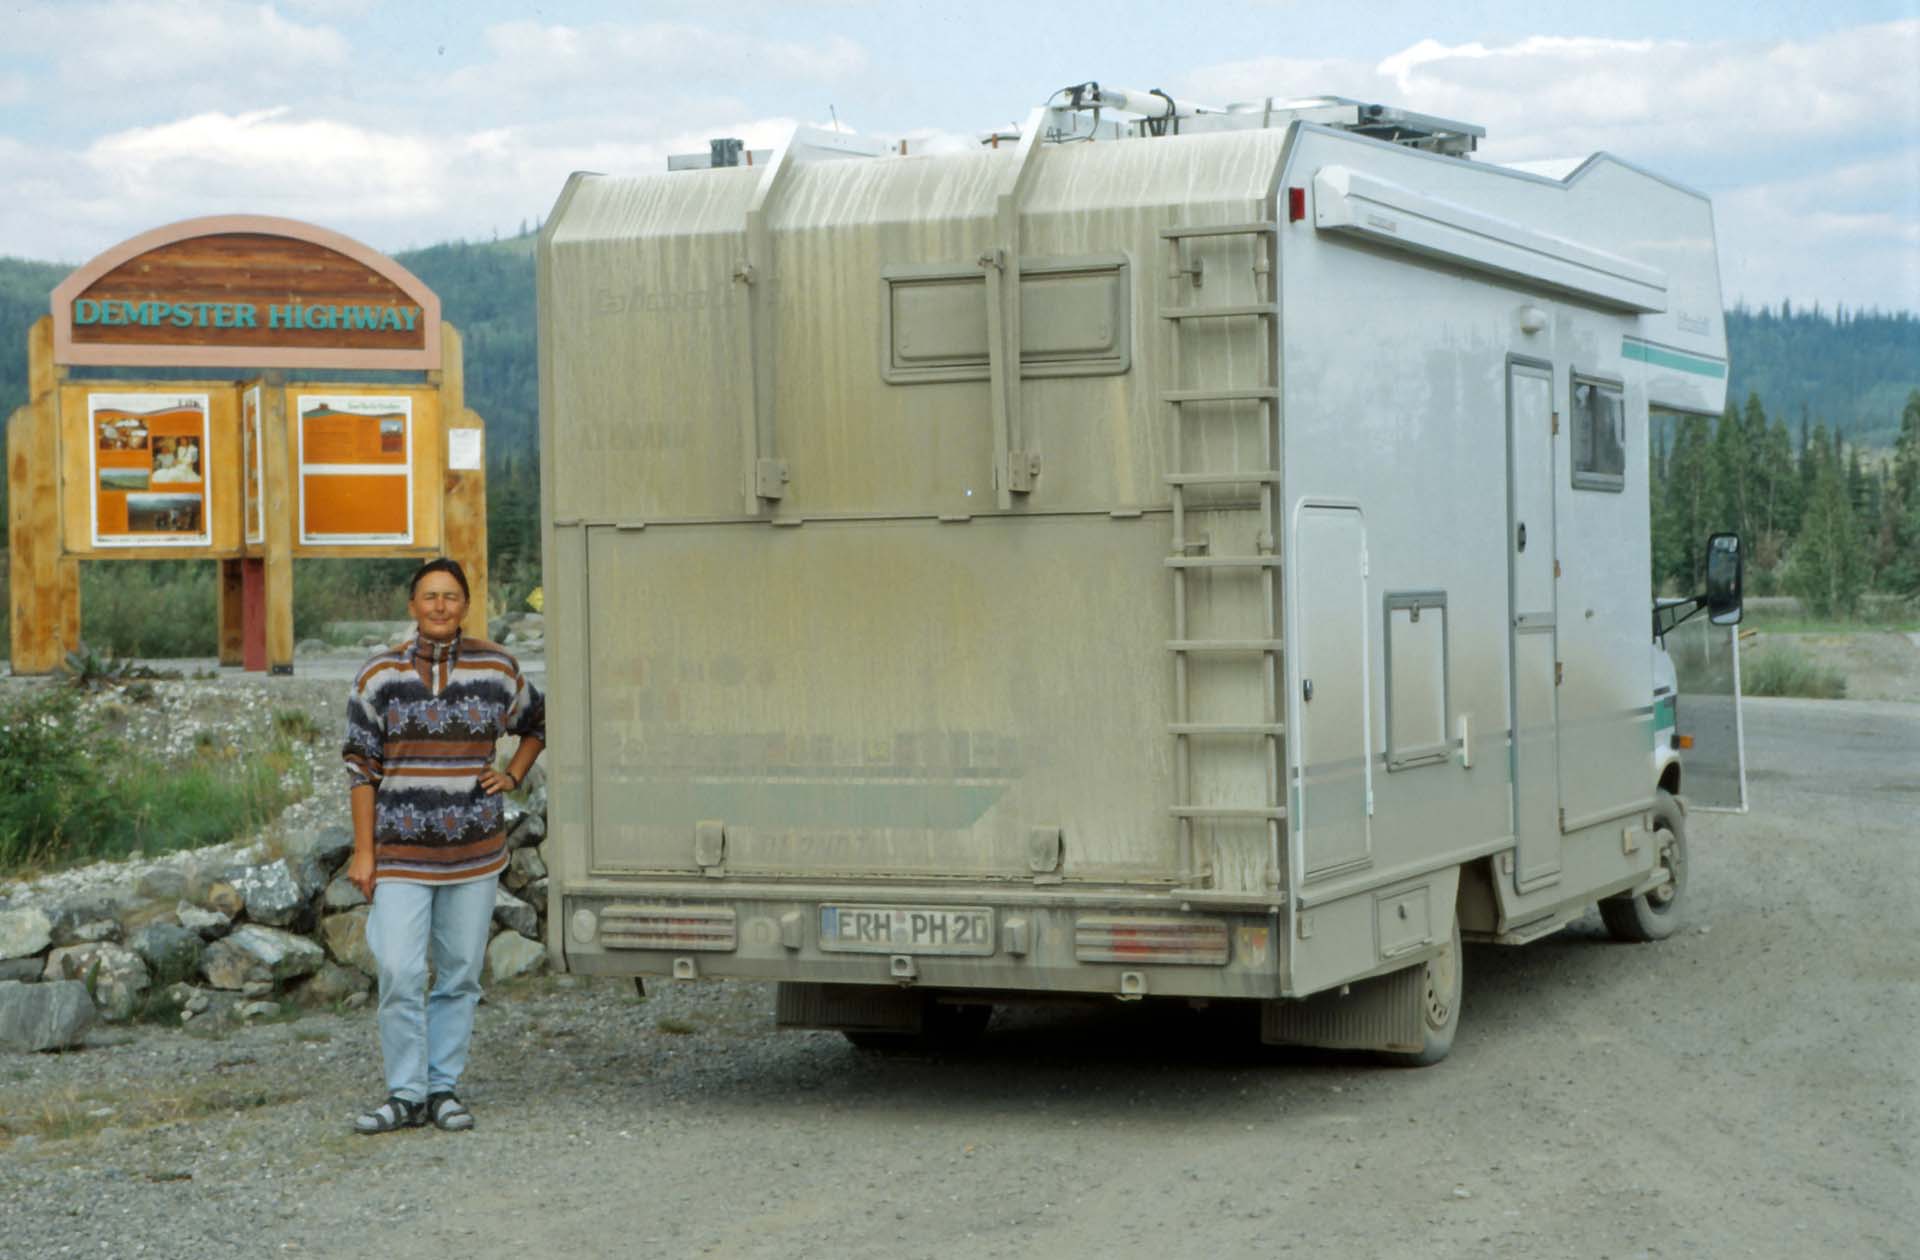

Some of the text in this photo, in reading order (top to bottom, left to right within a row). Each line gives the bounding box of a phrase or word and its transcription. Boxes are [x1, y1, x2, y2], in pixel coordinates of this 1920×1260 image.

[74, 298, 421, 331] DEMPSTER HIGHWAY
[838, 911, 892, 942] ERH
[911, 914, 947, 944] PH
